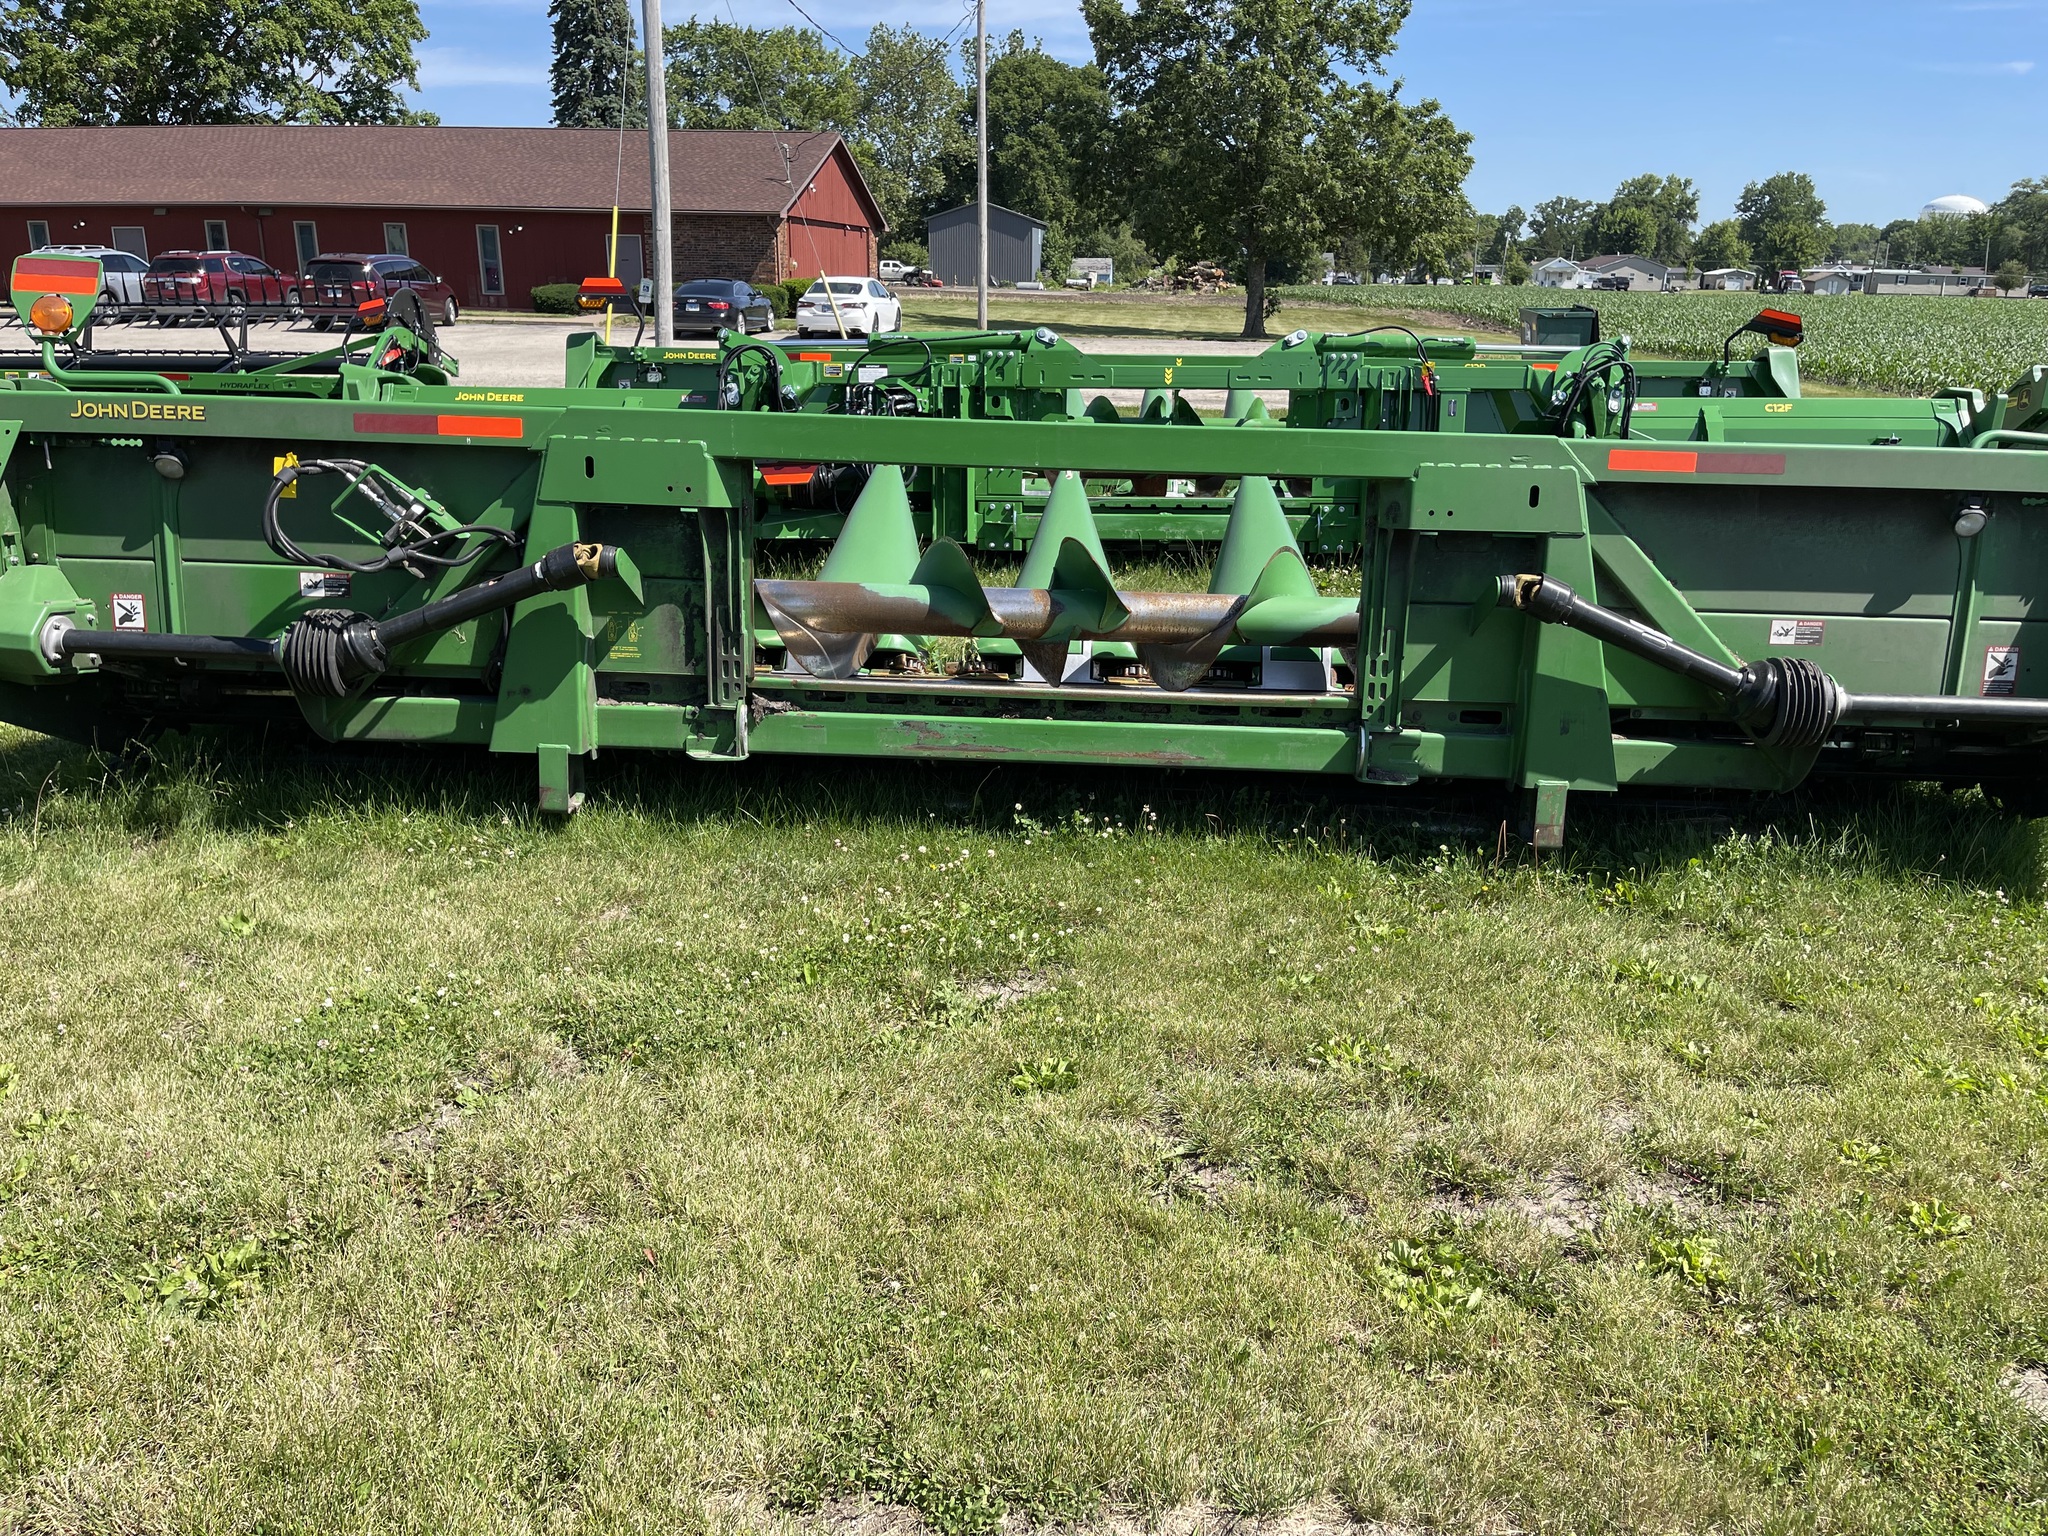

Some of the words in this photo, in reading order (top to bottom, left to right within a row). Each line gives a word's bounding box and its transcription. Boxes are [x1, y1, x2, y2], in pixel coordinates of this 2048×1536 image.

[663, 351, 687, 360] JOHN
[687, 352, 717, 360] DEERE
[220, 382, 270, 390] HYDRAFLEX
[454, 391, 485, 401] JOHN
[486, 392, 524, 402] DEERE
[70, 399, 129, 419] JOHN
[131, 400, 206, 421] DEERE
[1764, 403, 1793, 413] C12F
